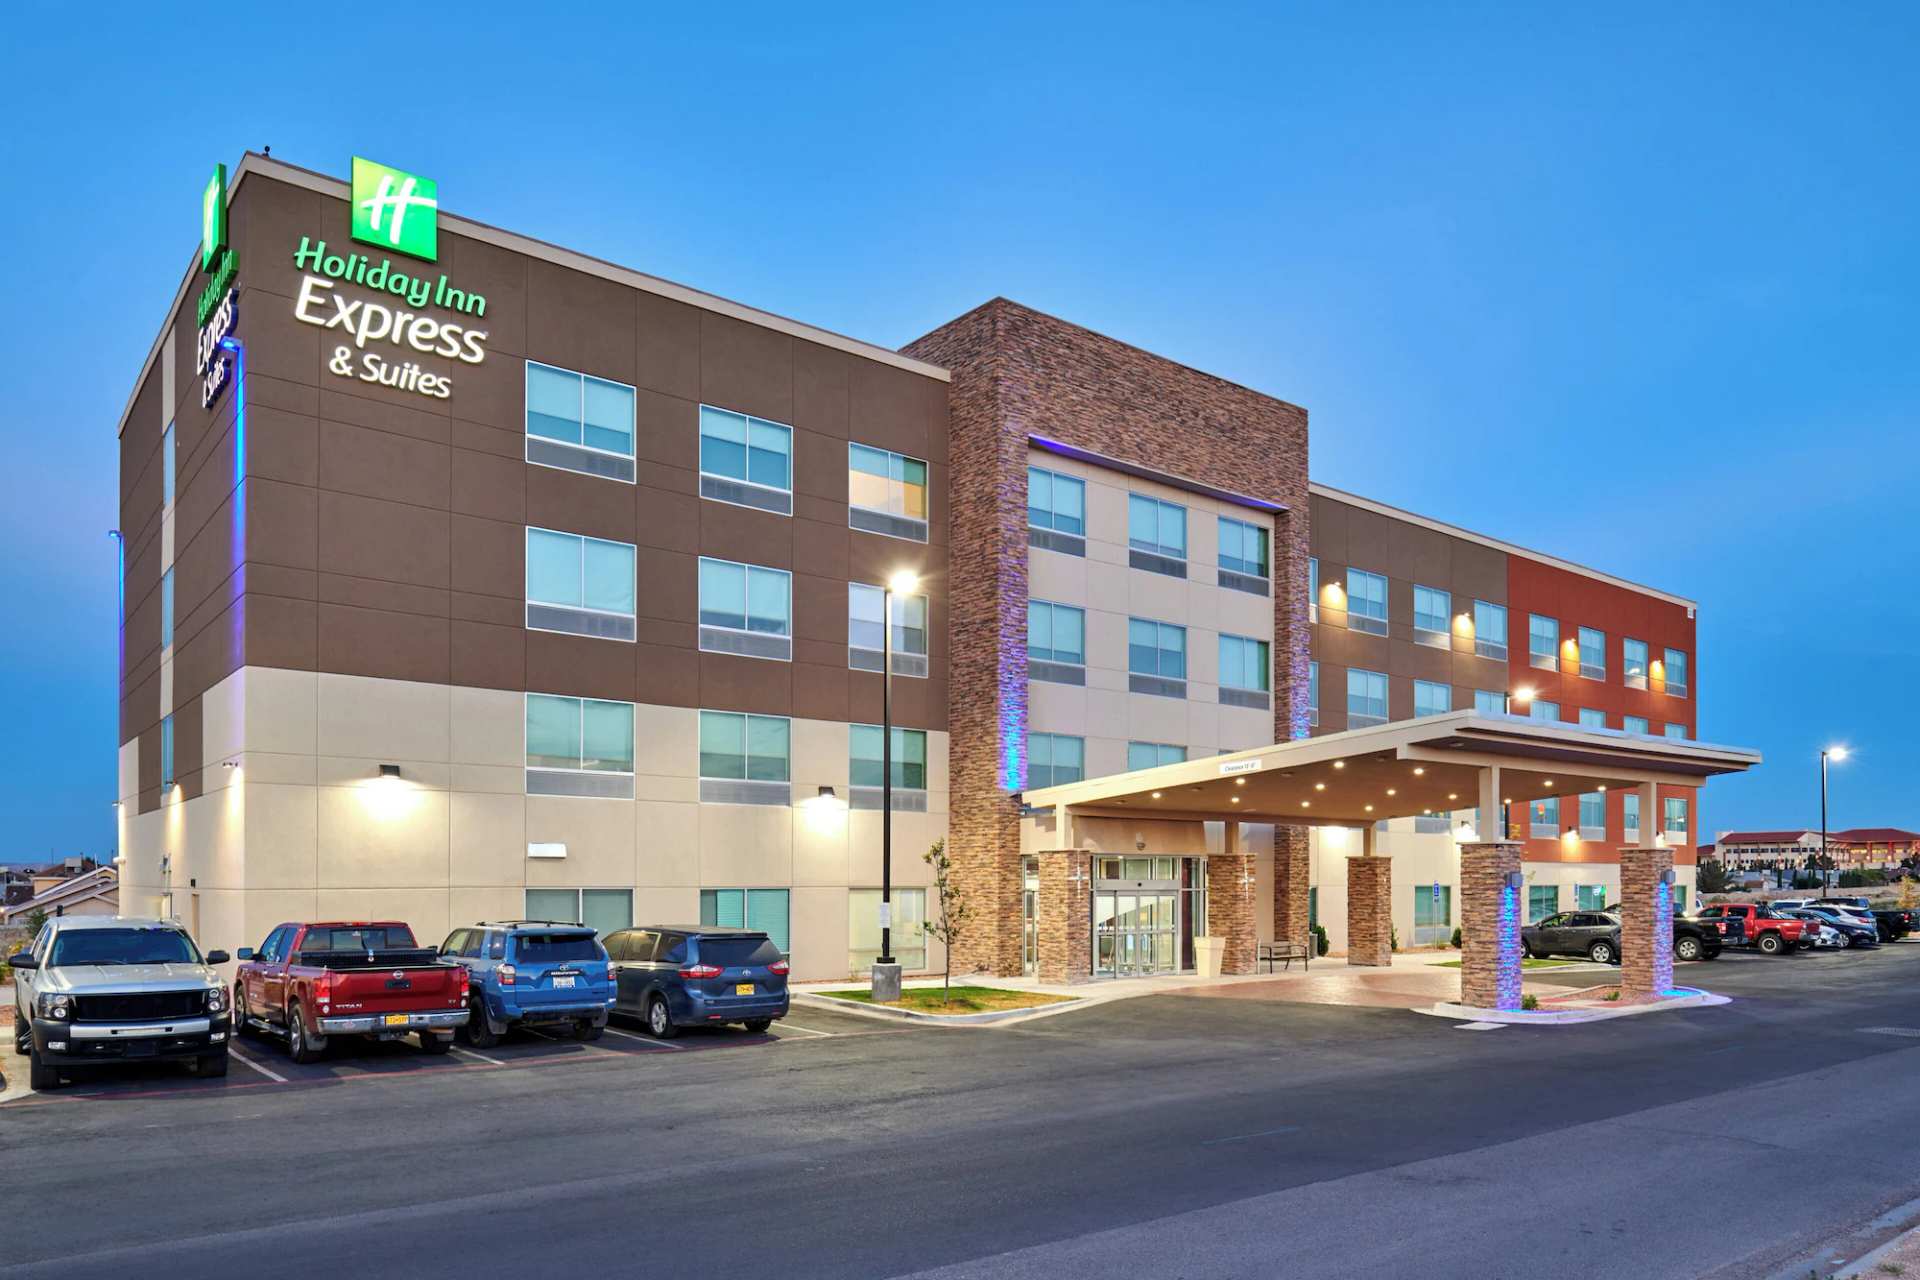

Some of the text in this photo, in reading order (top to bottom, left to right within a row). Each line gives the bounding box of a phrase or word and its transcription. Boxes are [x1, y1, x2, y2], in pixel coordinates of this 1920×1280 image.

[294, 236, 487, 317] Holiday Inn
[196, 287, 233, 376] Express
[295, 275, 487, 364] Express
[329, 345, 453, 399] & Suites
